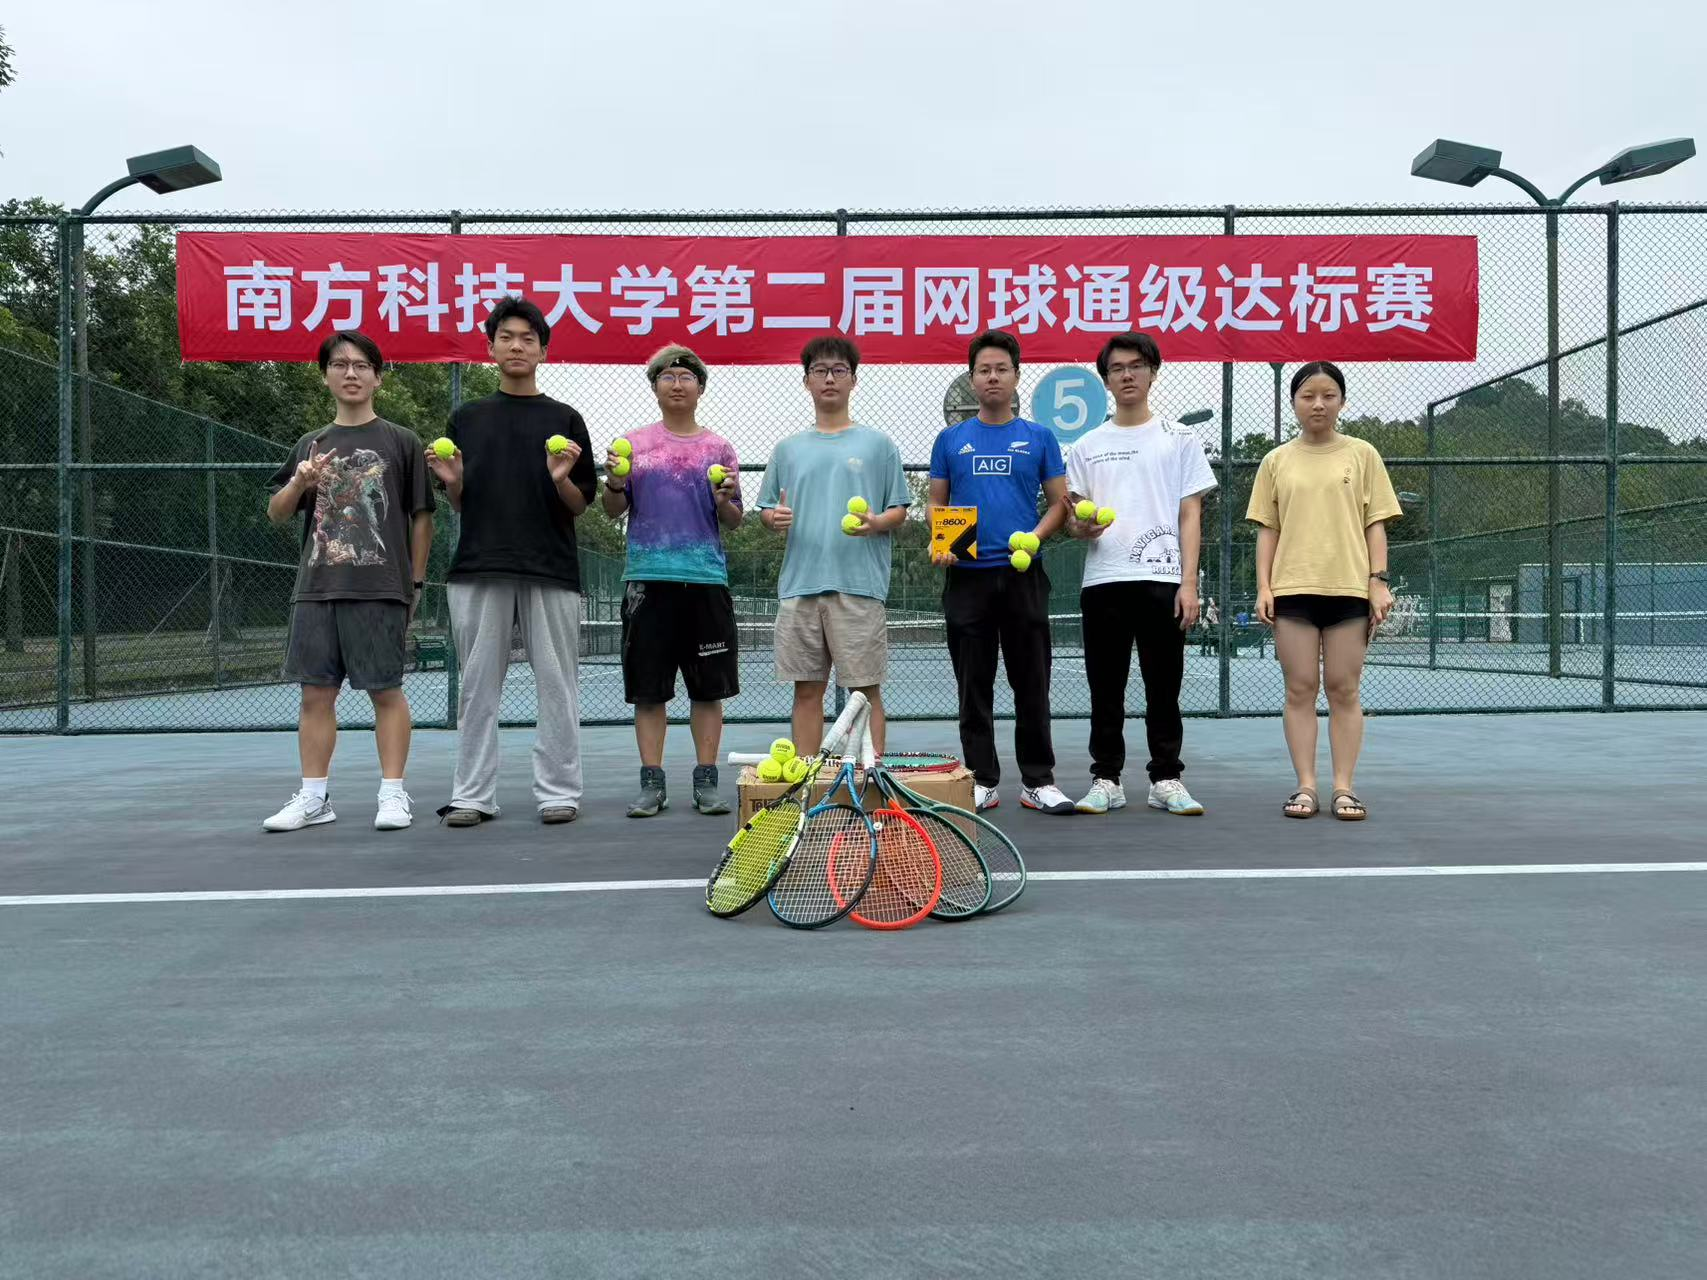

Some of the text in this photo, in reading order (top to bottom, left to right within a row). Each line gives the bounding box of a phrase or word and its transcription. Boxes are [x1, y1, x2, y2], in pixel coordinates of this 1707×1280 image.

[223, 260, 1434, 336] 南方科技大学第二届网球通级达标赛
[1053, 378, 1088, 431] 5
[977, 458, 1007, 472] AIG
